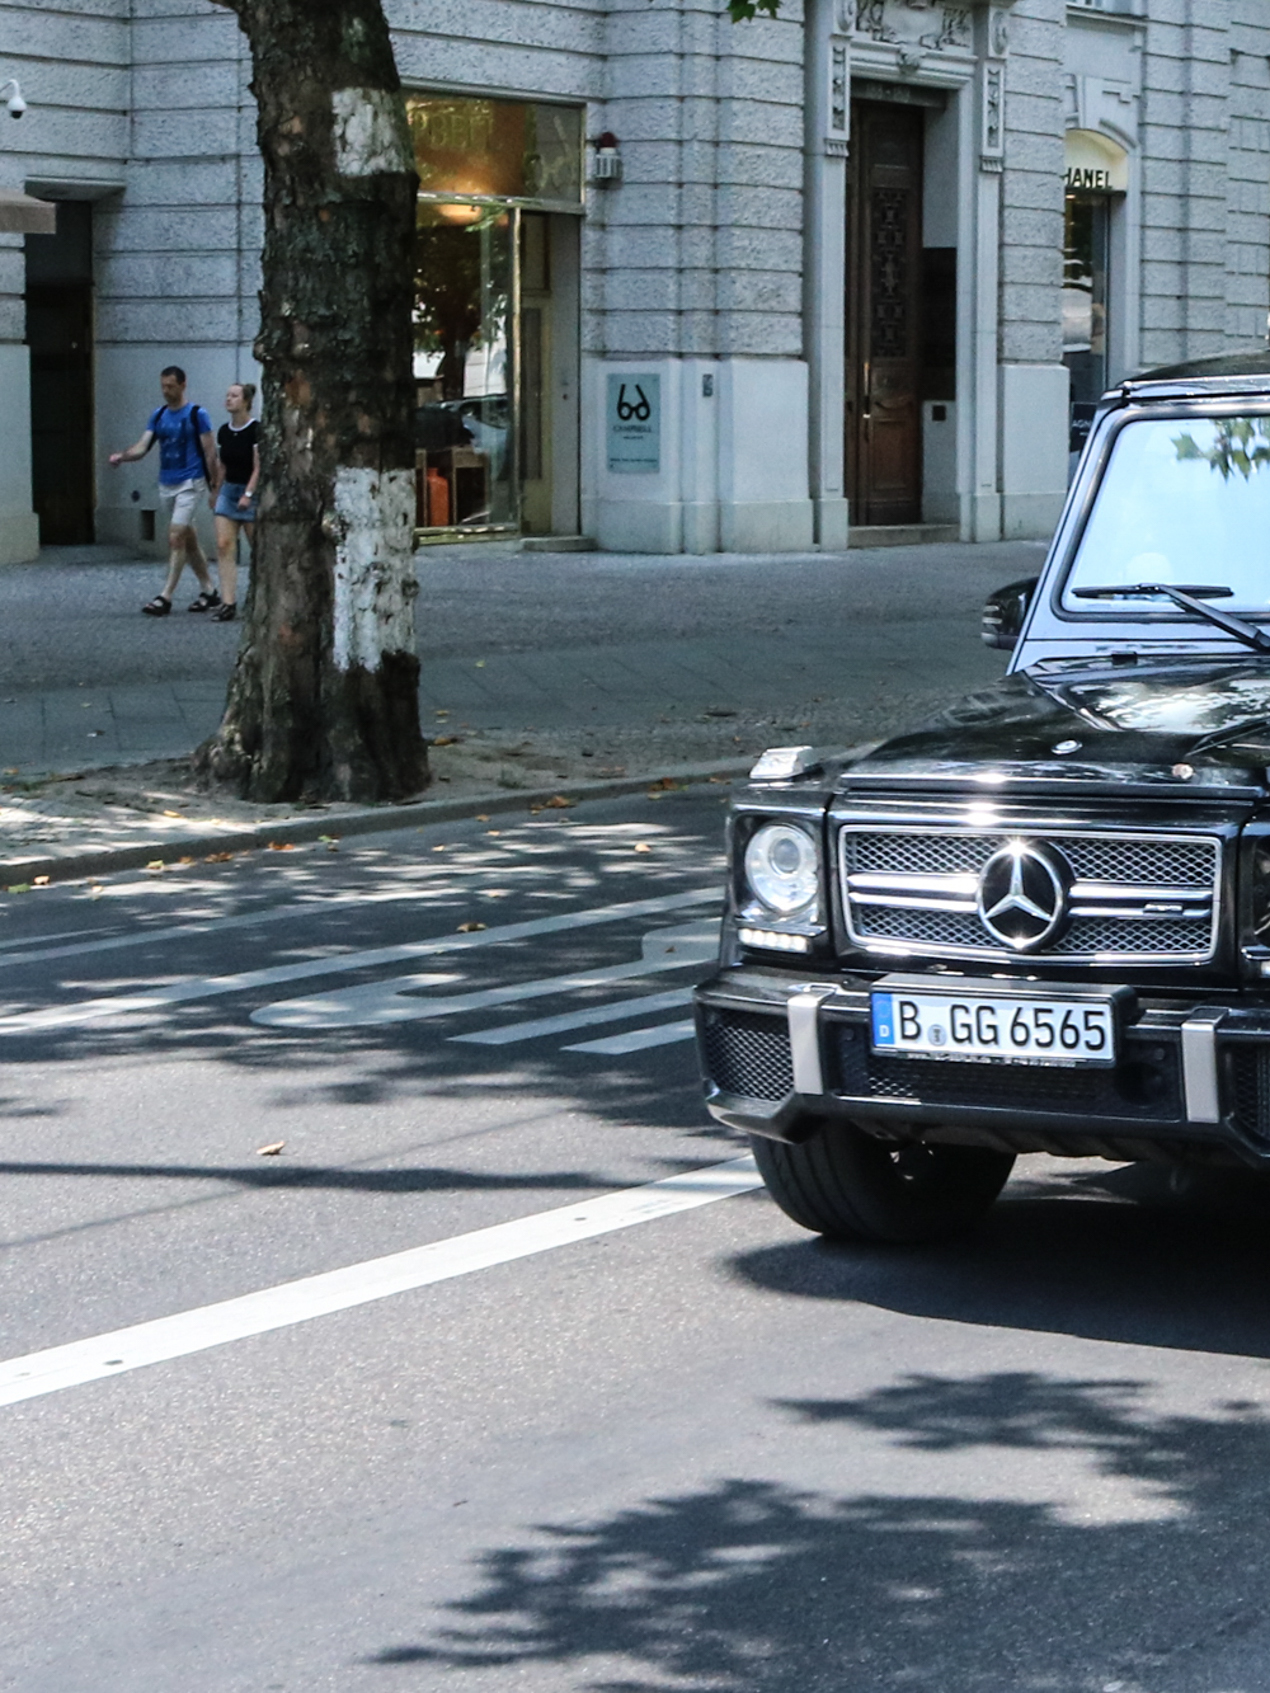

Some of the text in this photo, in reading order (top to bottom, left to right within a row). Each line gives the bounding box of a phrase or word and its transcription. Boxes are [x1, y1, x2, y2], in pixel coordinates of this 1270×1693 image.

[878, 1024, 890, 1038] D
[899, 1000, 1106, 1051] B GG 6565
